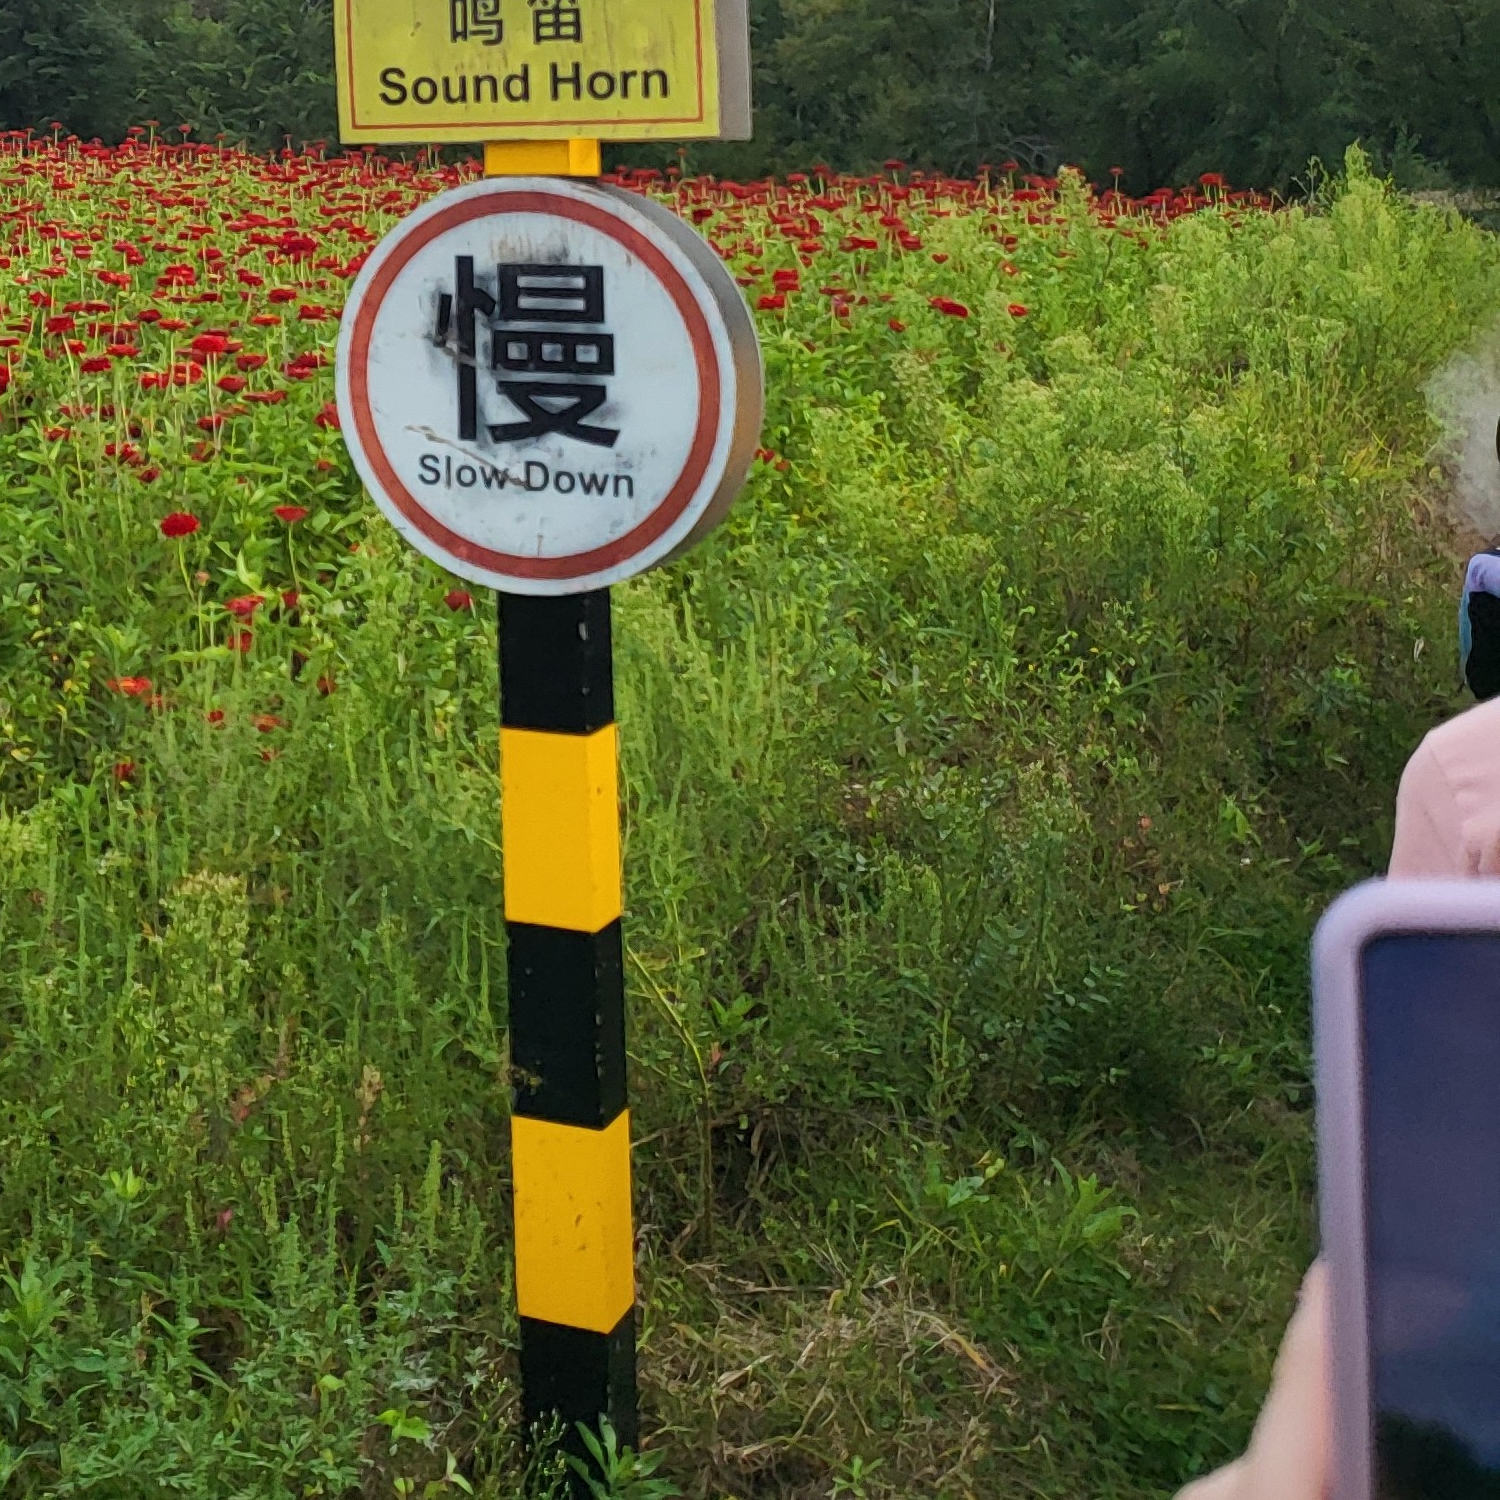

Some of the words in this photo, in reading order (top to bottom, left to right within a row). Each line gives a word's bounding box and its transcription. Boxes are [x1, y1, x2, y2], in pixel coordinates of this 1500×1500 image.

[378, 63, 530, 106] Sound
[550, 61, 670, 101] Horn
[433, 255, 621, 448] 慢
[417, 454, 512, 489] Slow
[523, 460, 635, 499] Down
